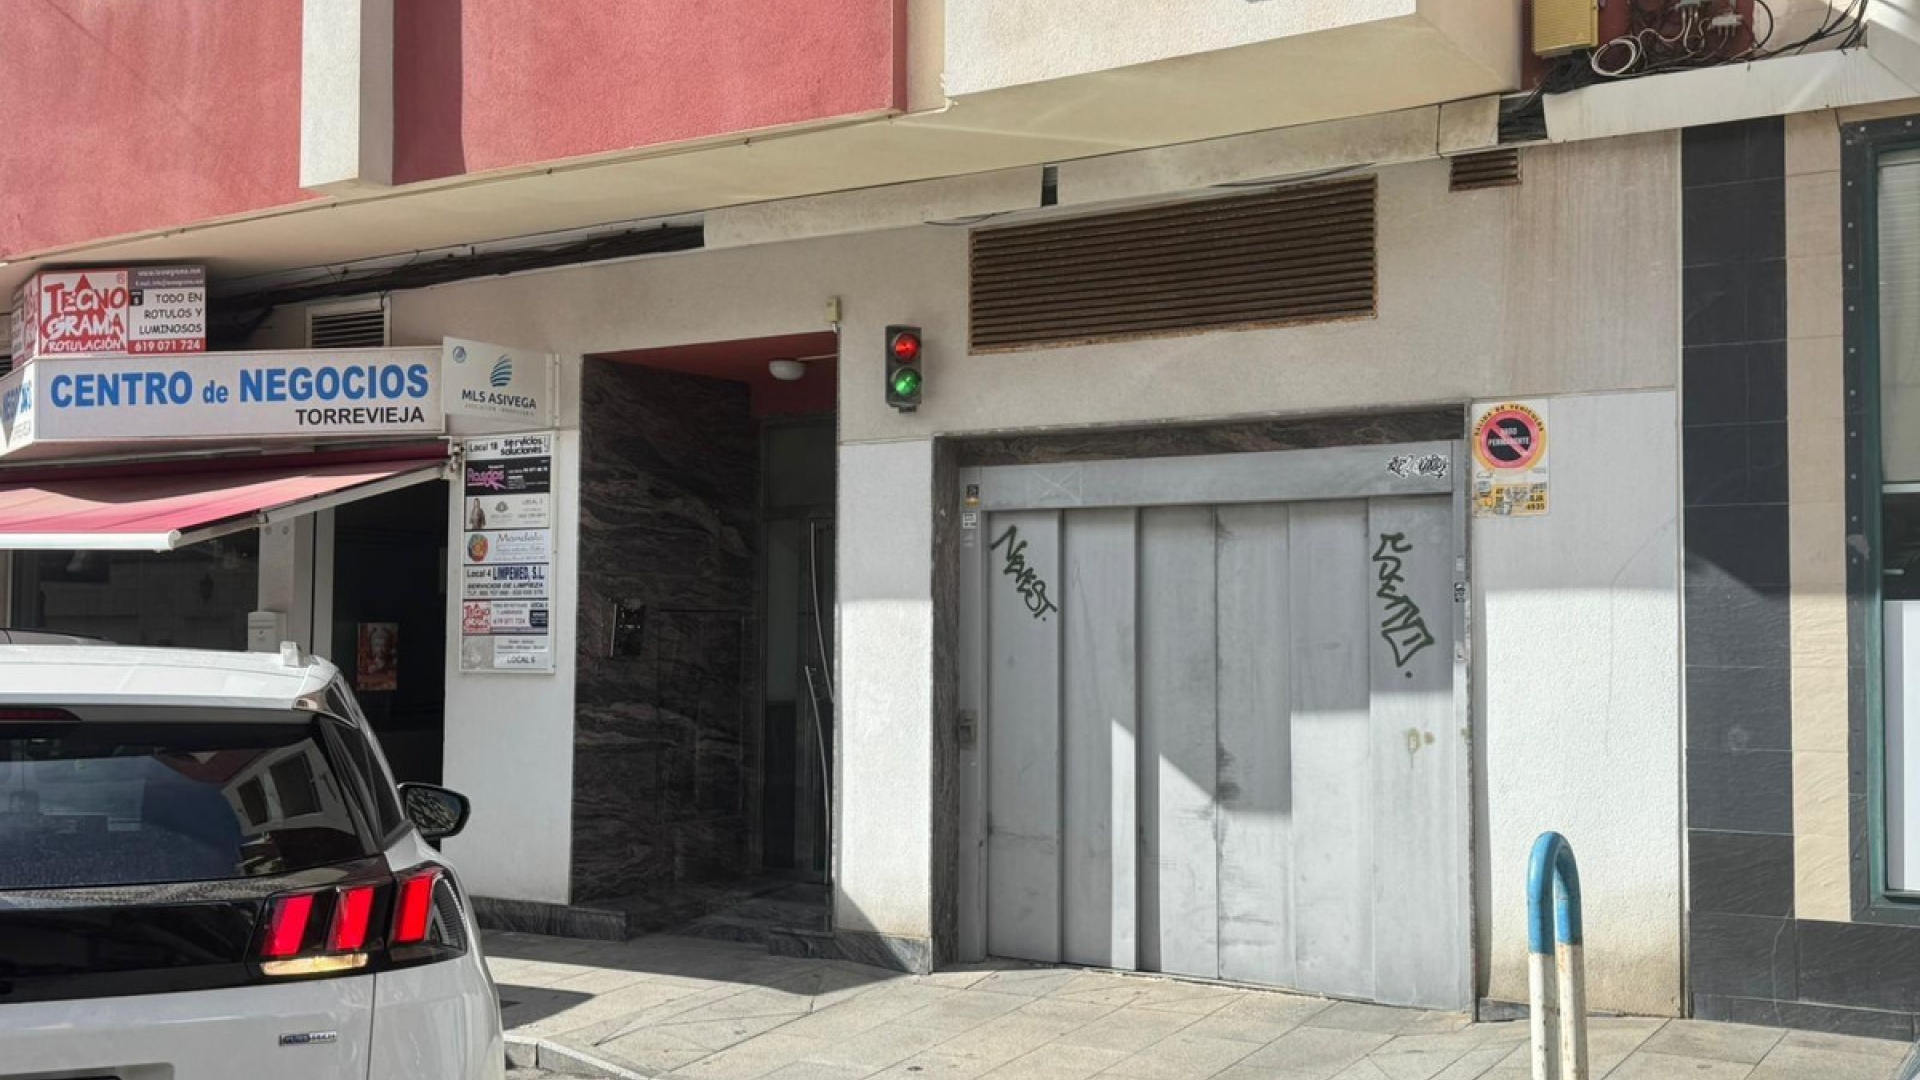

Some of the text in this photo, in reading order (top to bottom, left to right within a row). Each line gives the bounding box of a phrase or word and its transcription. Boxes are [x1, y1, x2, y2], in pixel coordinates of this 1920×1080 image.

[45, 282, 127, 314] TECNO
[156, 292, 203, 304] TODO EN
[144, 308, 203, 320] ROTULOS Y
[41, 313, 124, 340] GRAMA
[139, 323, 202, 335] LUMINOSOS
[50, 338, 121, 351] ROTULACIÓN
[135, 340, 200, 352] 619 071 724
[50, 371, 193, 408] CENTRO
[202, 380, 229, 404] de
[240, 364, 429, 402] NEGOCIOS
[461, 388, 486, 403] MLS
[488, 392, 537, 410] ASIVEGA
[295, 407, 425, 426] TORREVIEJA
[467, 569, 485, 578] Local
[507, 656, 530, 664] LOCAL
